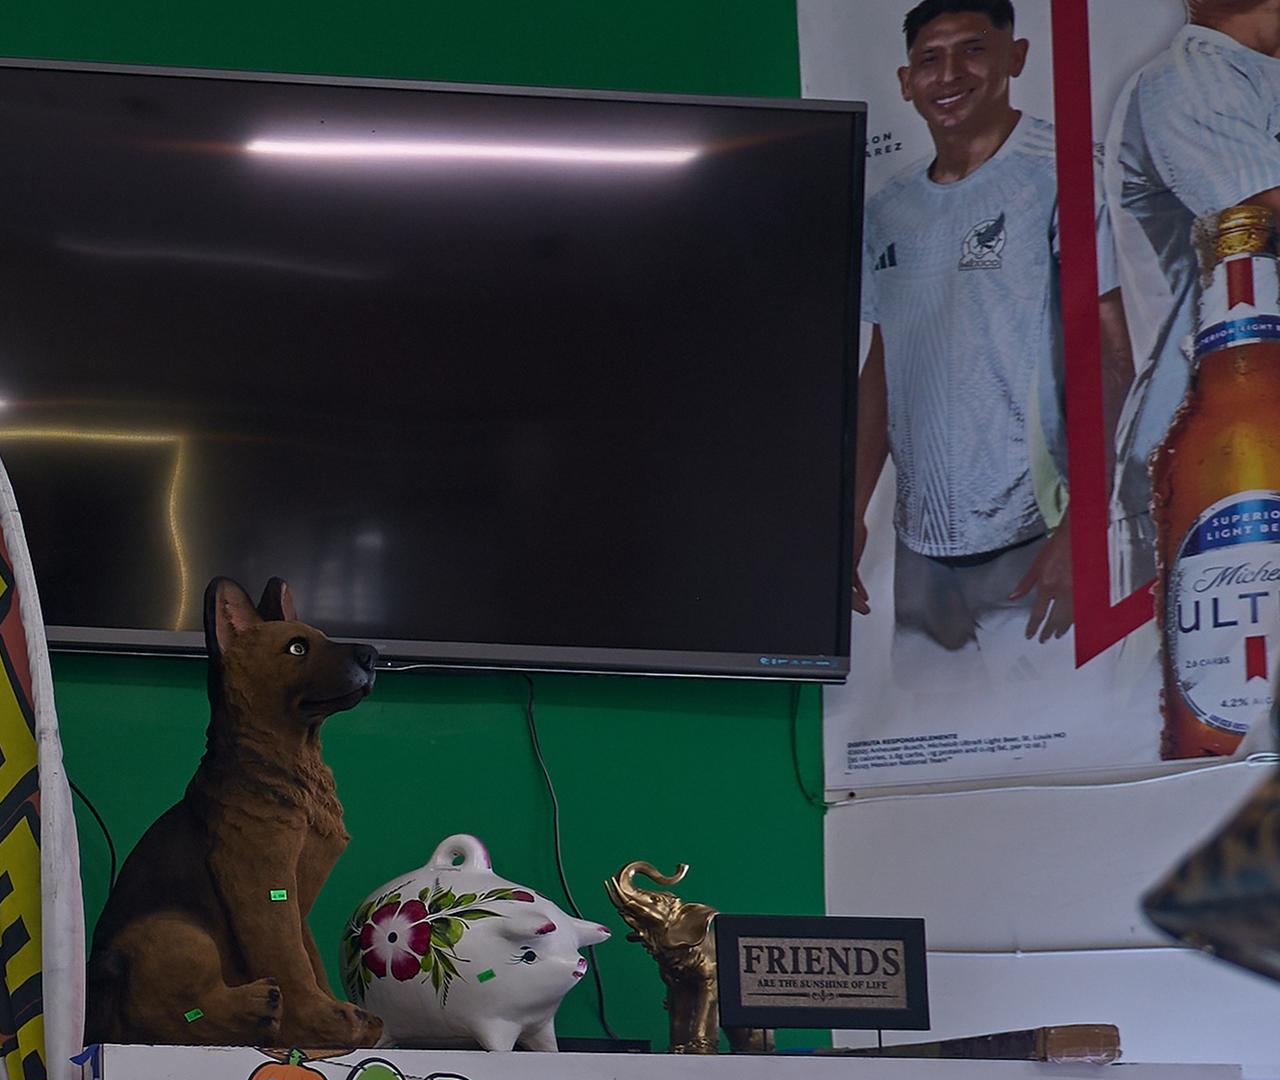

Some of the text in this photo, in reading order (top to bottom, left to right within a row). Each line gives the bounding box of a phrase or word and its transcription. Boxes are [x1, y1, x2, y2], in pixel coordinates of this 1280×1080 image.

[1212, 509, 1280, 527] SUPERIO
[1207, 524, 1251, 540] LIGHT
[1178, 592, 1270, 633] ULT
[743, 945, 900, 977] FRIENDS
[757, 979, 887, 989] ARE THE SUNSHINE OF LIFE
